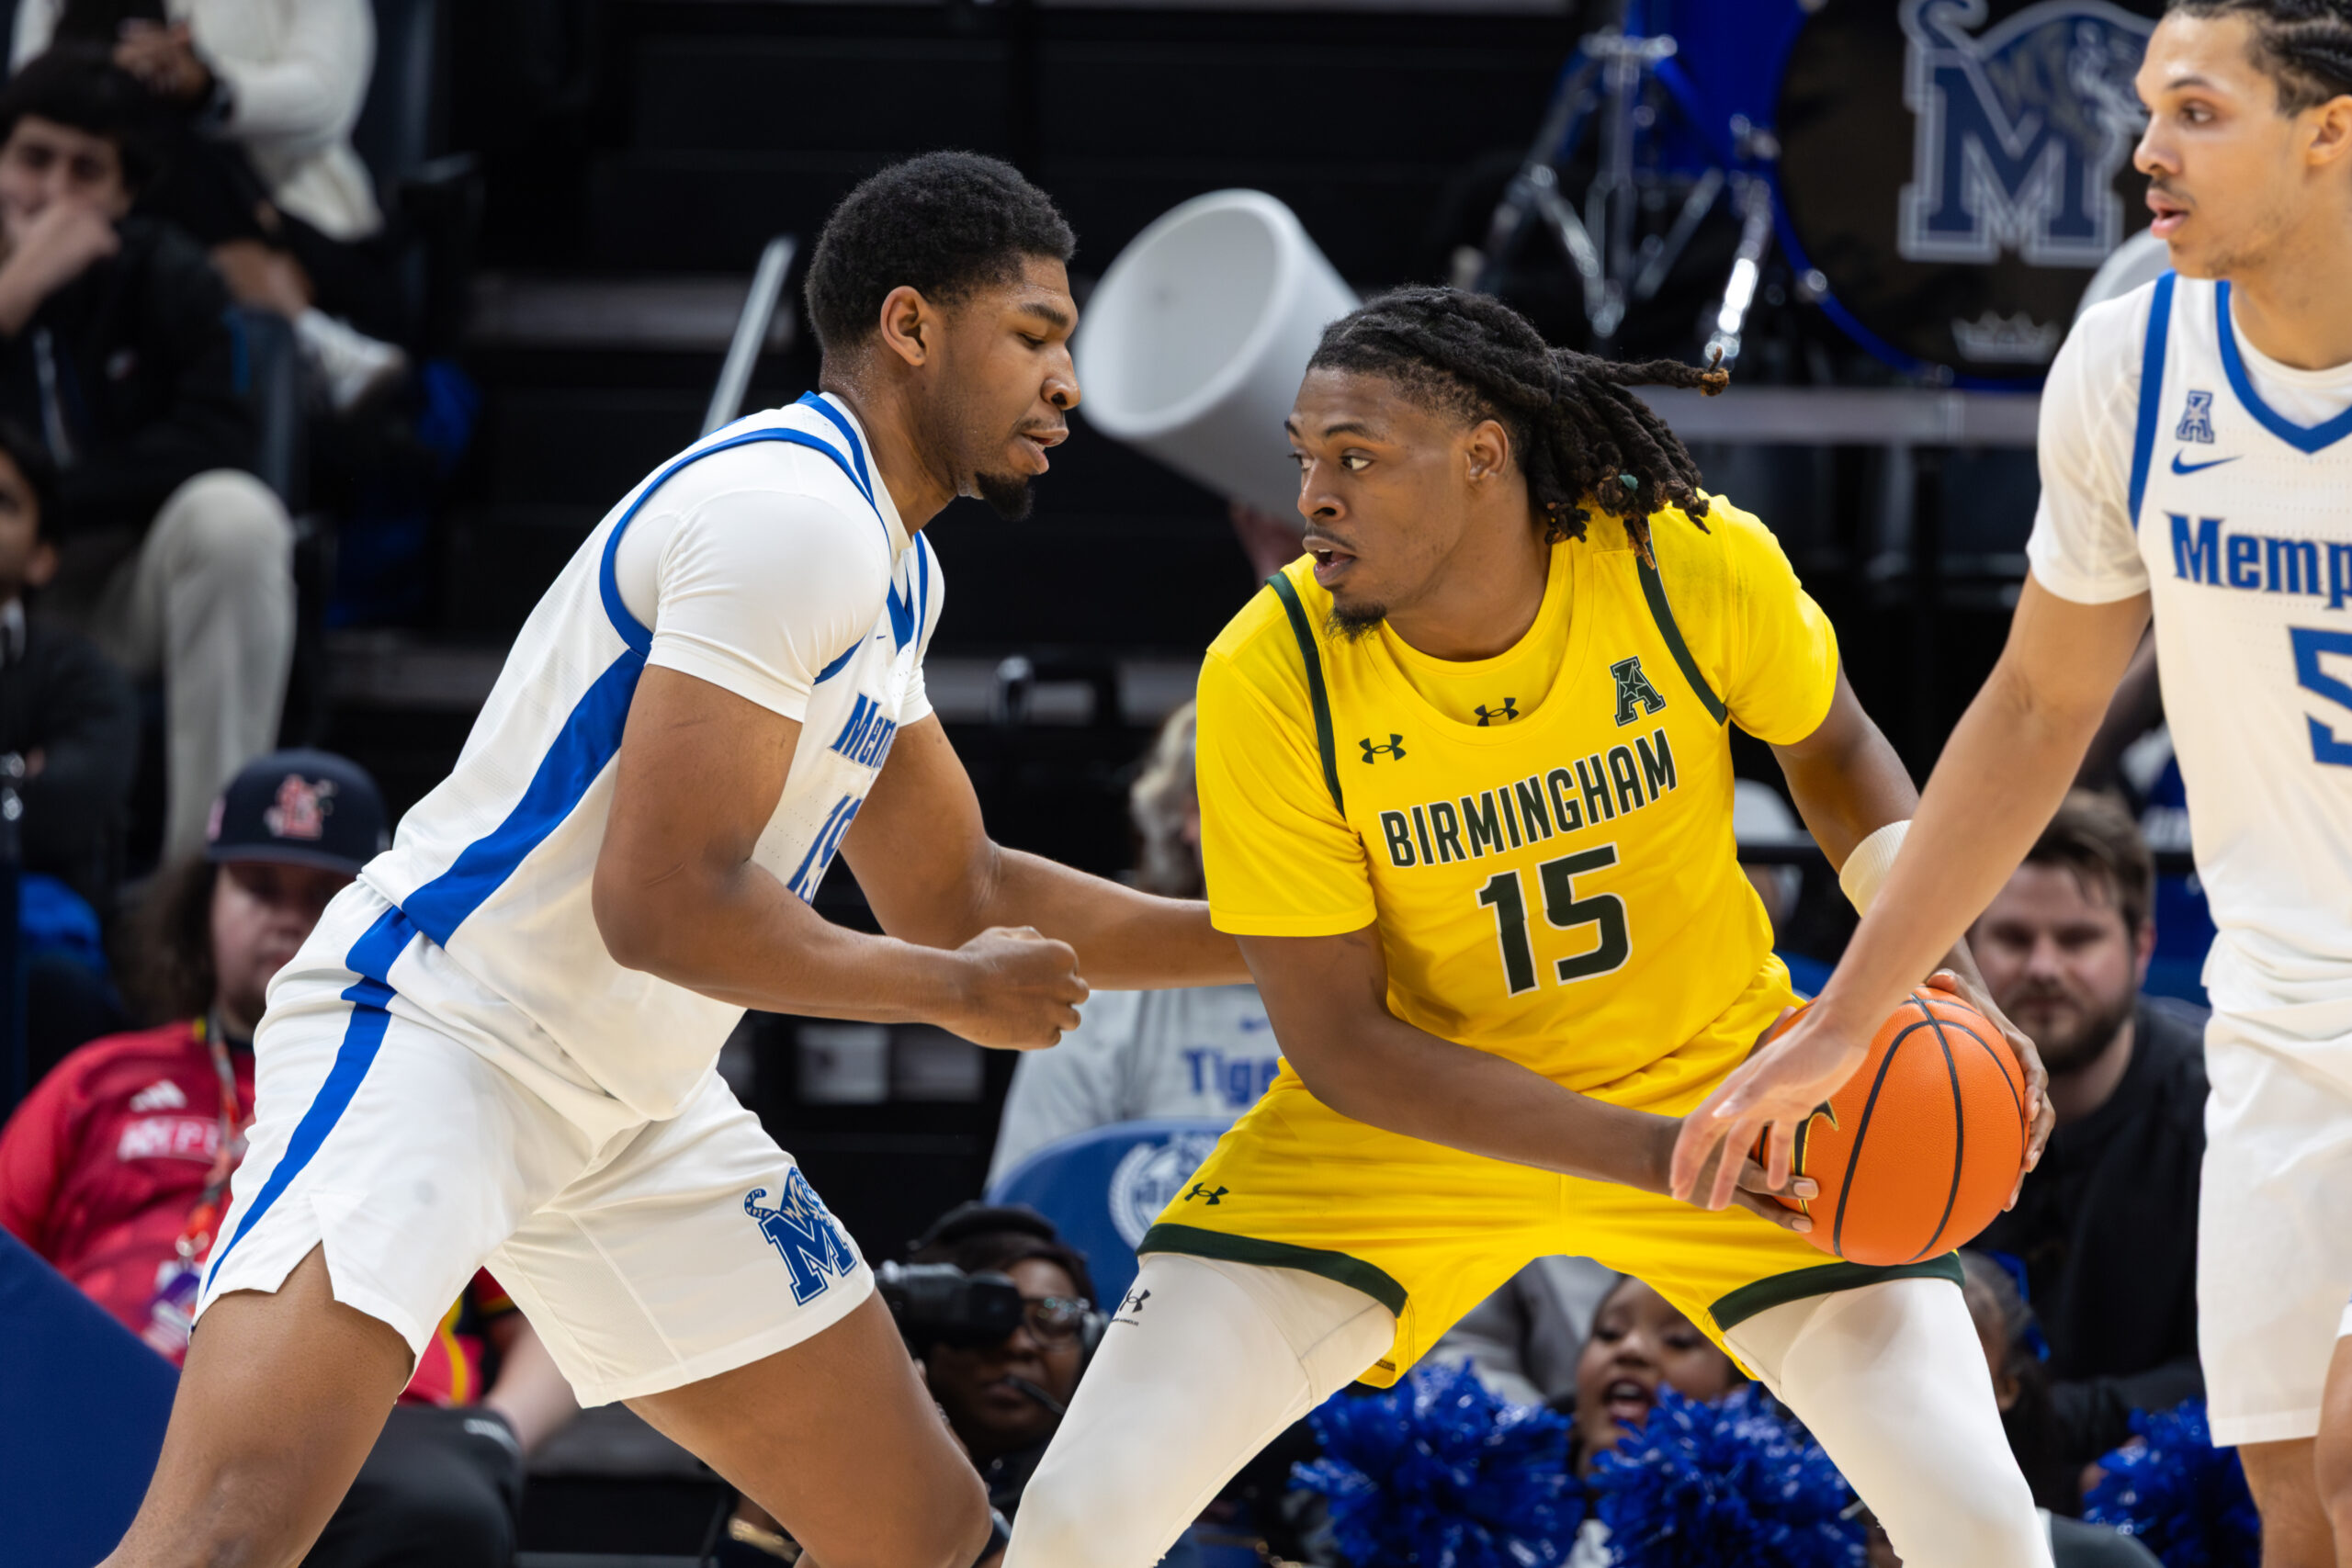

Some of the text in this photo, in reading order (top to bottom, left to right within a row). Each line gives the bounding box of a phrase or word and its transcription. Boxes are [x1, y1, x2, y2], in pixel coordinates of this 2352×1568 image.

[2288, 625, 2352, 768] 5
[1380, 727, 1678, 867] BIRMINGHAM
[1475, 841, 1633, 998] 15
